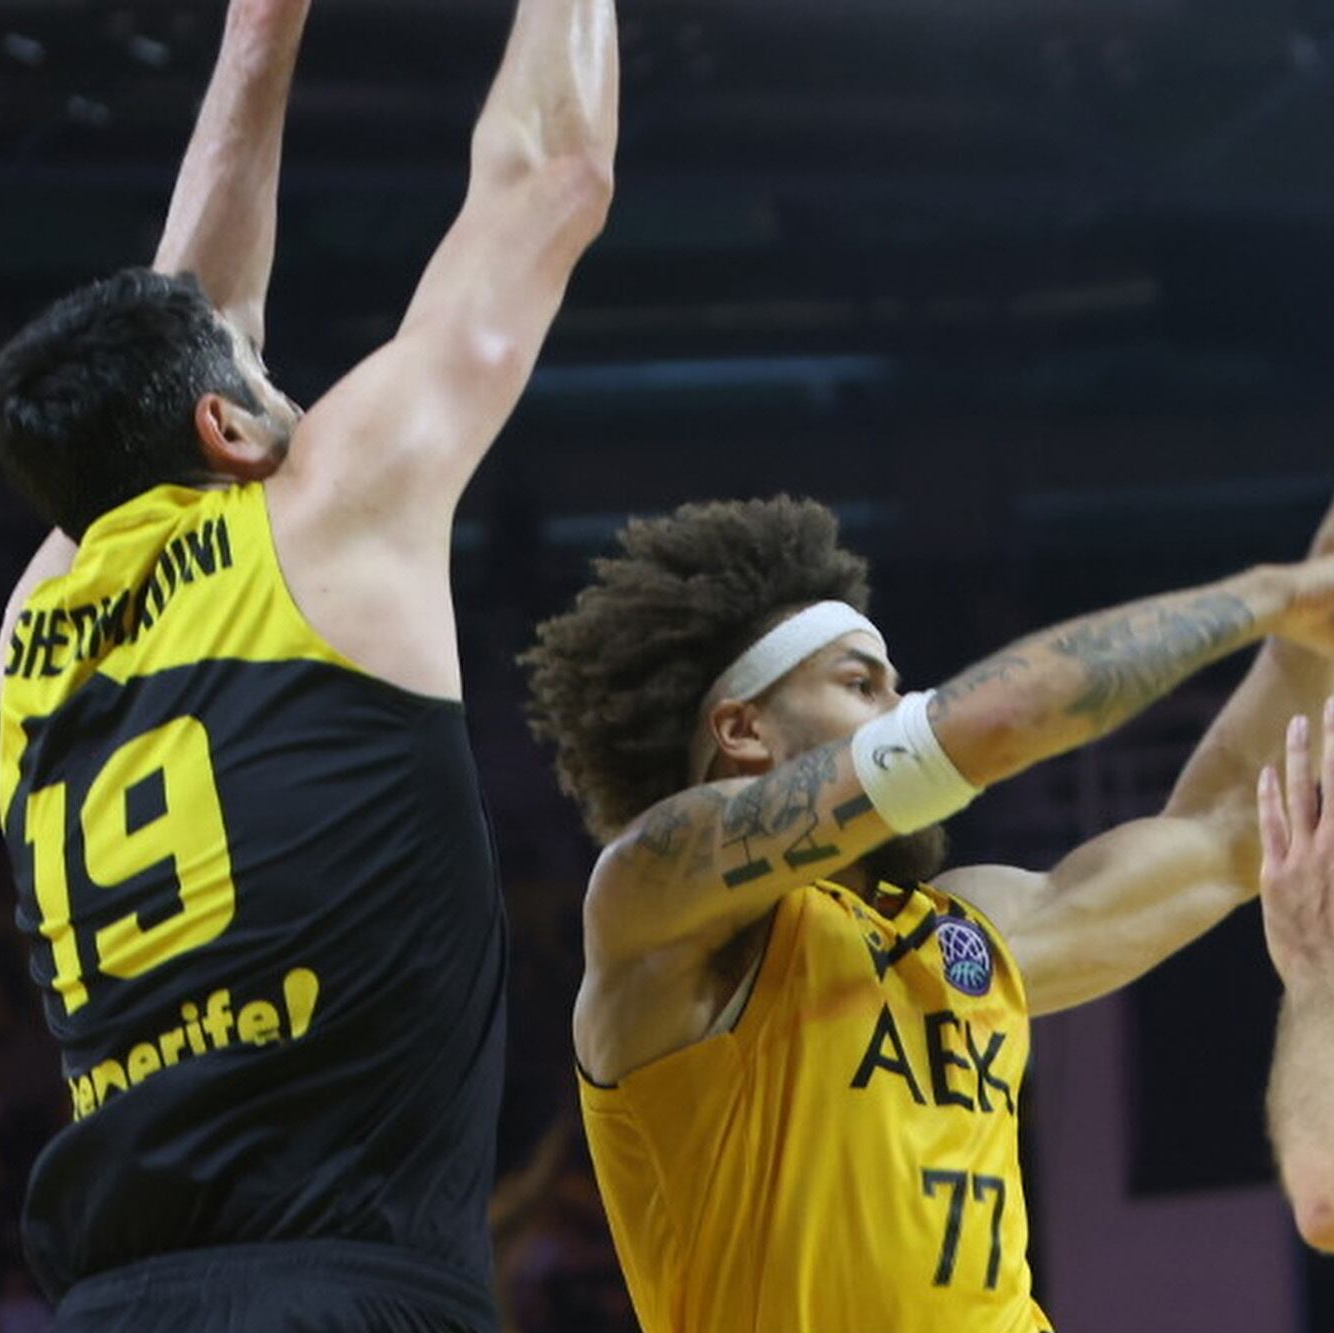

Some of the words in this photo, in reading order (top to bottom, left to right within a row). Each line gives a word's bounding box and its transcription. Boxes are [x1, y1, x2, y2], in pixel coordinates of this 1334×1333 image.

[25, 714, 238, 1016] 19
[850, 1002, 1016, 1117] AEK
[921, 1168, 1005, 1290] 77
